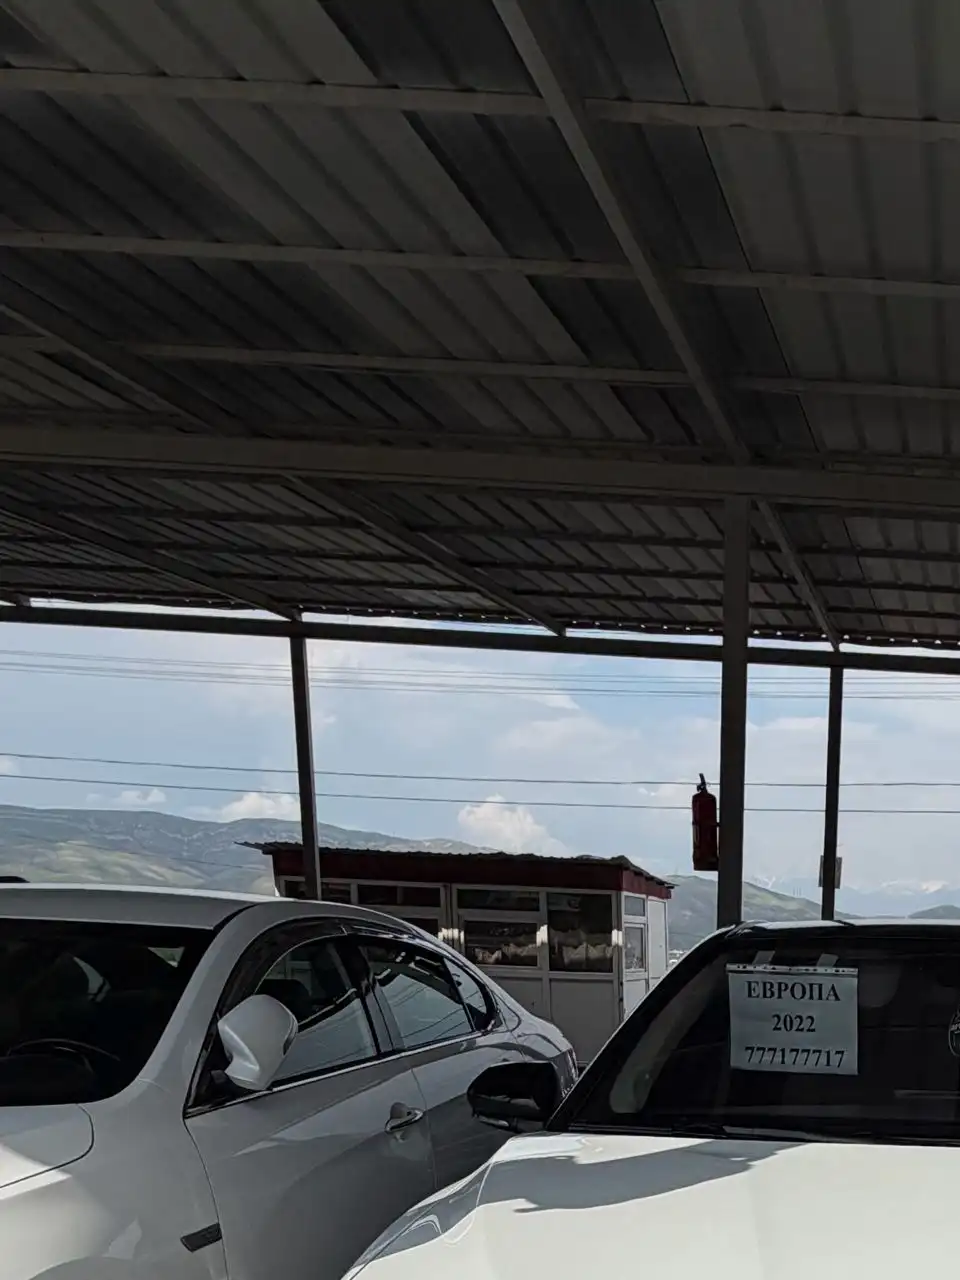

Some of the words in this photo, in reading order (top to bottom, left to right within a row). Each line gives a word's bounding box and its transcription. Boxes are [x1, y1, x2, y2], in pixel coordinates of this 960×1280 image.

[745, 980, 841, 1002] ЕВРОПА
[771, 1013, 816, 1033] 2022
[744, 1046, 845, 1068] 777177717
